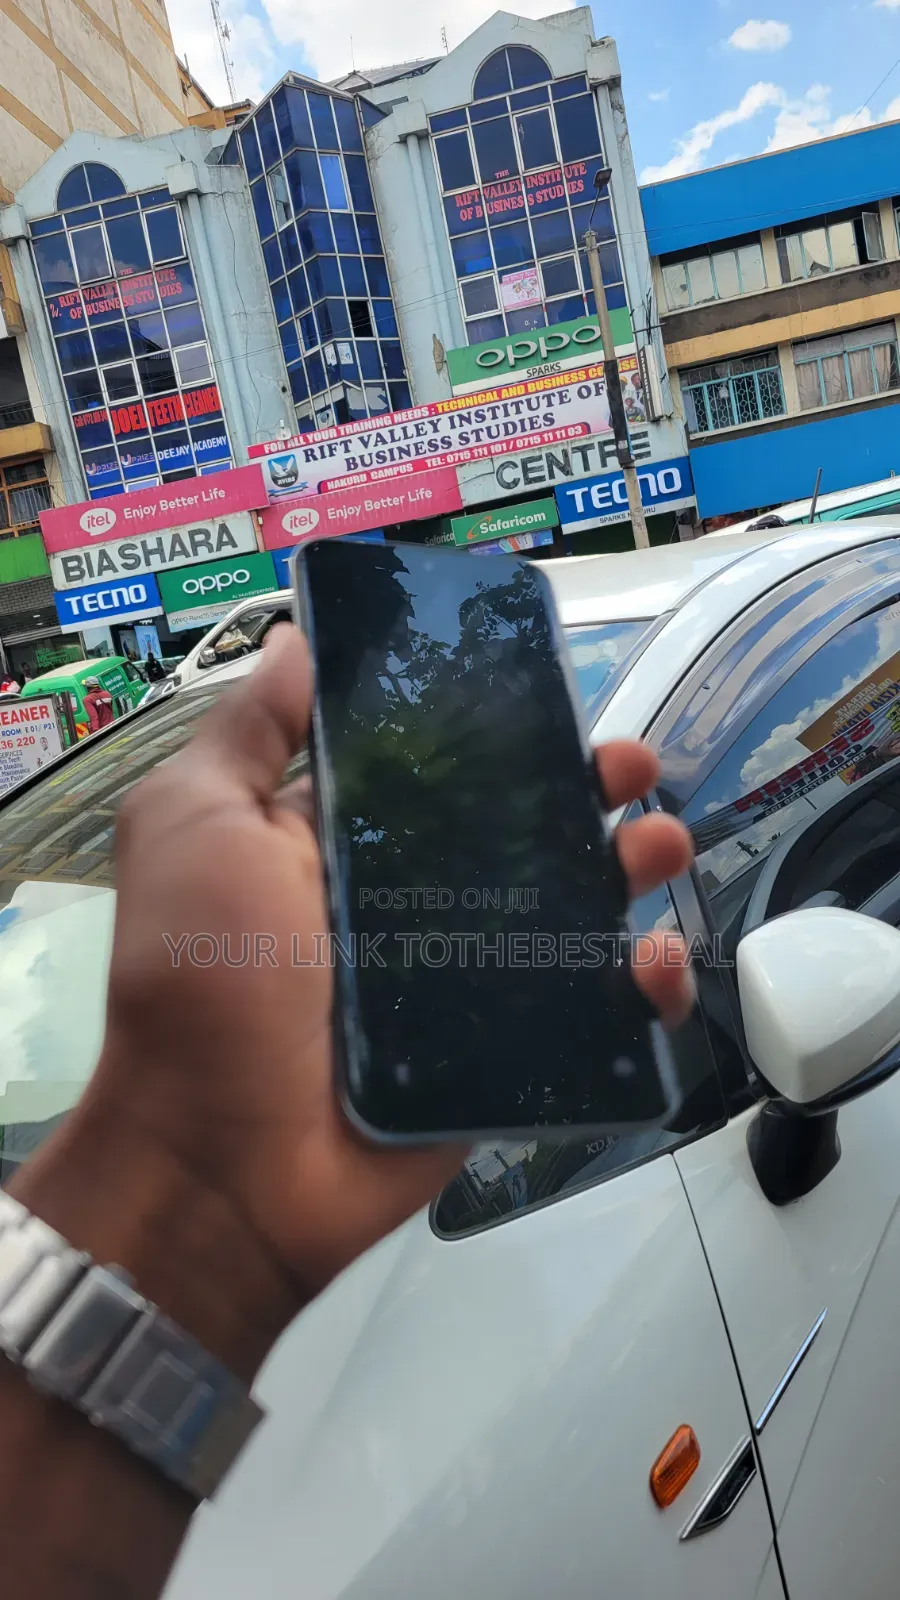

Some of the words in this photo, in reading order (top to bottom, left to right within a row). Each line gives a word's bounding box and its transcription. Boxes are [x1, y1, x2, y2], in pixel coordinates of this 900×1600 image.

[455, 189, 480, 207] RIFT
[483, 179, 523, 201] VALLEY
[525, 162, 587, 189] INSTITUTE
[495, 169, 509, 179] THE
[459, 207, 473, 222] OF
[476, 193, 535, 218] BUSINESS
[536, 180, 585, 203] STUDIES
[58, 288, 81, 308] RIFT
[82, 280, 119, 303] VALLEY
[121, 269, 177, 294] INSTITUTE
[120, 268, 134, 276] THE
[69, 304, 83, 320] OF
[86, 293, 135, 317] BUSINESS
[134, 282, 183, 304] STUDIES
[526, 362, 561, 378] SPARKS
[110, 403, 147, 435] JOEL
[145, 394, 185, 427] TEETH
[264, 439, 285, 454] FOR
[287, 433, 306, 449] ALL
[307, 426, 338, 443] YOUR
[338, 414, 392, 437] TRAINING
[392, 408, 429, 426] NEEDS
[435, 389, 499, 414] TECHNICAL
[501, 384, 525, 399] AND
[527, 370, 587, 393] BUSINESS
[588, 359, 638, 380] COSE
[302, 439, 355, 463] RIFT
[357, 417, 442, 450] VALLEY
[450, 388, 572, 430] INSTITUTE
[577, 381, 606, 400] OF
[157, 444, 190, 461] DEEJAY
[193, 435, 227, 452] ACADEMY
[327, 473, 368, 490] NAKURU
[370, 463, 414, 480] CAMPUS
[425, 453, 446, 468] TEL:
[446, 447, 472, 464] 0715
[473, 446, 488, 460] 111
[490, 441, 509, 456] 101
[515, 434, 541, 449] 0715
[542, 431, 554, 443] 11
[556, 428, 567, 440] 11
[567, 424, 583, 437] 03
[344, 432, 451, 472] BUSINESS
[458, 412, 556, 447] STUDIES
[495, 430, 652, 491] CENTRE
[87, 511, 112, 530] itel
[123, 504, 157, 521] Enjoy
[159, 493, 200, 512] Better
[202, 487, 226, 502] Life
[289, 511, 314, 530] itel
[327, 504, 362, 522] Enjoy
[364, 494, 406, 512] Better
[408, 487, 433, 503] Life
[566, 467, 683, 514] TECNO
[479, 510, 547, 535] Safaricom
[599, 512, 627, 524] SPARKS
[628, 506, 656, 520] NURU
[61, 522, 239, 584] BIASHARA
[65, 583, 148, 616] TECNO
[171, 614, 188, 626] OPPO
[0, 705, 50, 727] EANER
[1, 728, 22, 737] ROOM
[43, 722, 56, 731] P21
[0, 739, 14, 751] 36
[16, 736, 36, 747] 220
